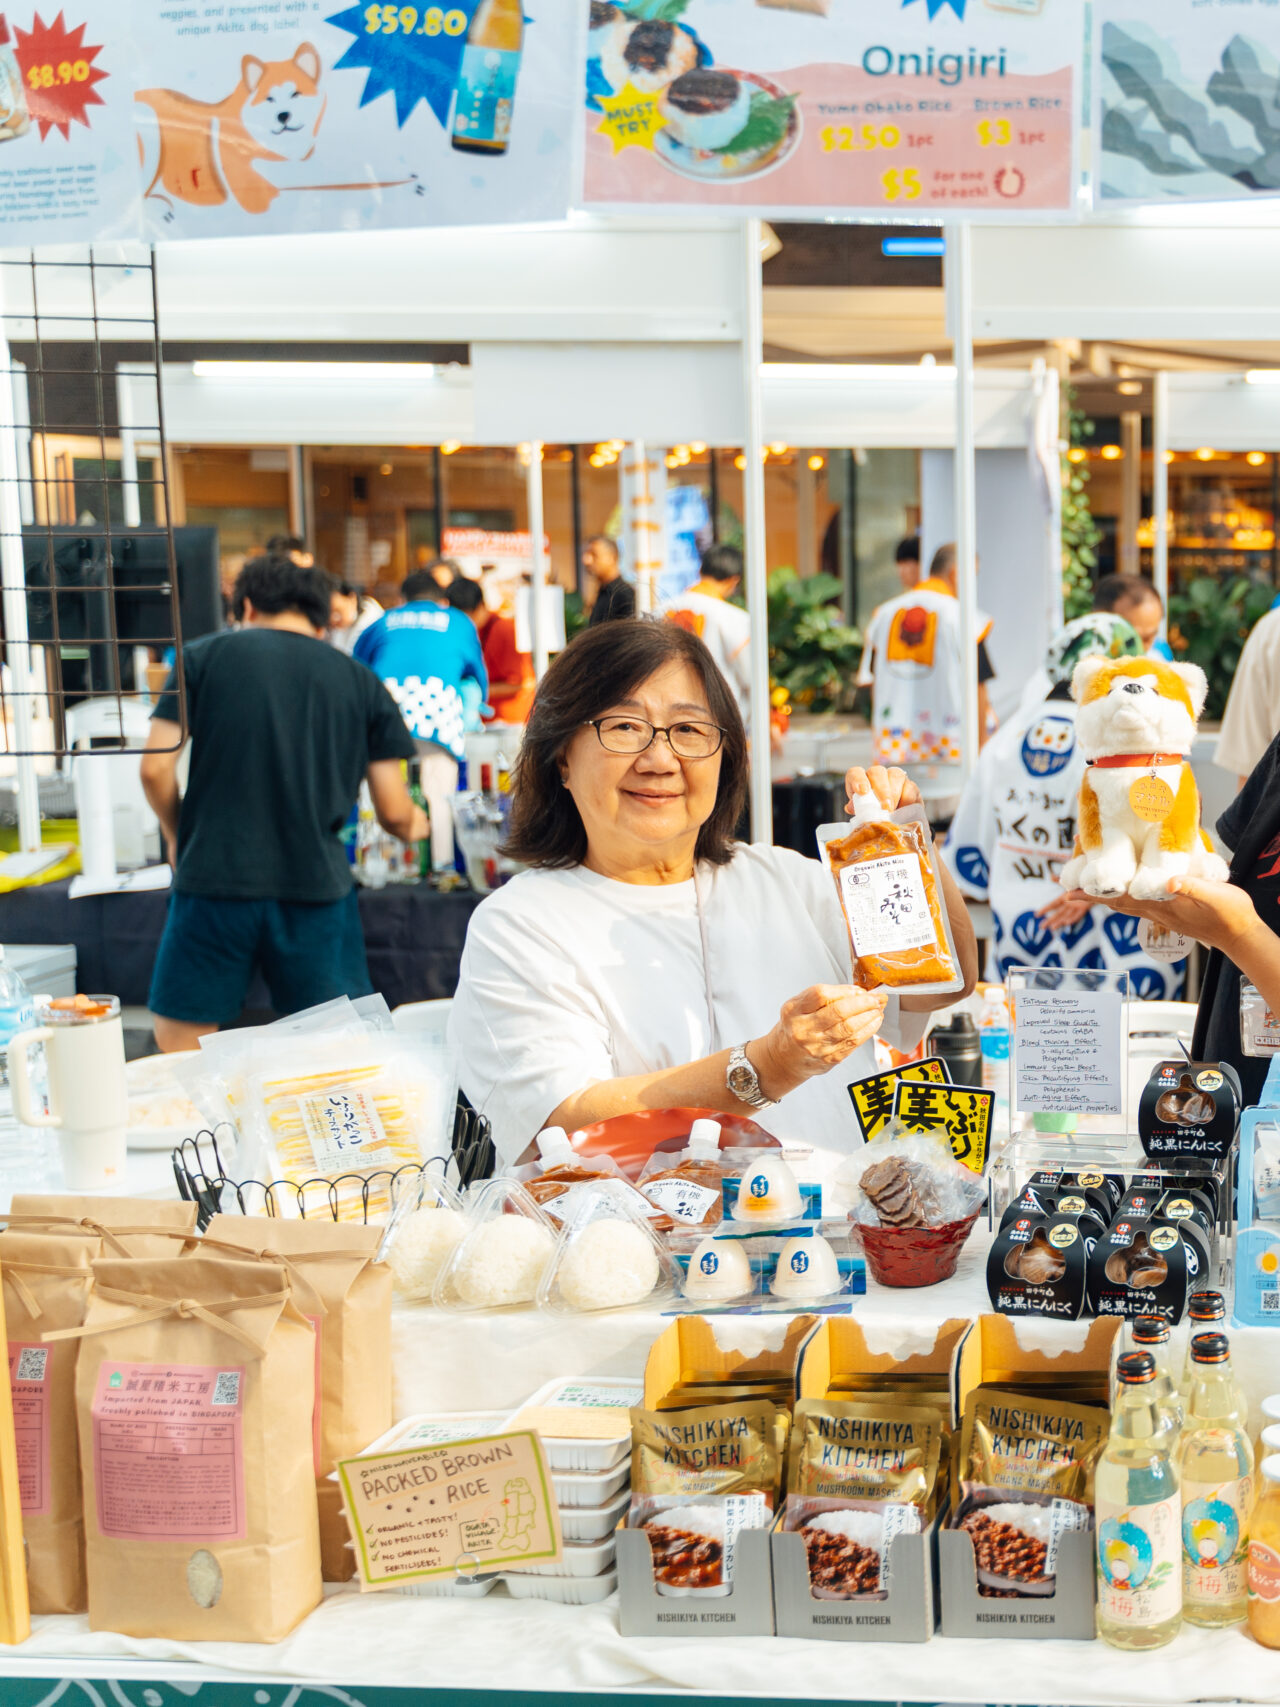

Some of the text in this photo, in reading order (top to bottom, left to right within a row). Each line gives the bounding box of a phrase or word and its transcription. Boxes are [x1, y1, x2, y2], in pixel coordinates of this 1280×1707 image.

[205, 6, 224, 16] and
[229, 4, 282, 17] presented
[364, 3, 468, 37] $59.80
[177, 25, 212, 37] unique
[216, 20, 246, 34] Akita
[250, 20, 269, 34] dog
[26, 58, 91, 91] $8.90
[862, 45, 1007, 87] Onigiri
[607, 101, 656, 124] MUST
[918, 99, 952, 113] Rice
[972, 96, 1063, 113] Brown Rice
[616, 117, 650, 137] TRY
[975, 117, 1046, 148] $3 1pc
[820, 124, 934, 153] $2.50 1pc
[881, 166, 923, 202] $5
[1021, 1074, 1040, 1082] Skin
[1149, 1138, 1223, 1152] 純黒にんにく
[996, 1294, 1073, 1315] 純黒にんにく
[1097, 1299, 1175, 1319] 純黒にんにく
[103, 1395, 145, 1404] Imported
[147, 1396, 168, 1404] from
[134, 1408, 176, 1417] polished
[178, 1409, 188, 1417] in
[191, 1410, 237, 1418] SINGAPORE
[653, 1416, 750, 1444] NISHIKIYA
[818, 1416, 915, 1444] NISHIKIYA
[989, 1406, 1085, 1441] NISHIKIYA
[662, 1443, 742, 1470] KITCHEN
[821, 1443, 906, 1471] KITCHEN
[991, 1434, 1076, 1464] KITCHEN
[360, 1442, 514, 1501] PACKED BROWN
[446, 1477, 491, 1504] RICE
[816, 1483, 865, 1496] MUSHROOM
[993, 1473, 1062, 1491] CHANA MASALA
[376, 1512, 459, 1534] ORGANIC TASTY!
[379, 1528, 450, 1548] NO PESTICIDES!
[466, 1538, 493, 1548] AKITA
[381, 1546, 441, 1561] NO CHEMICAL
[383, 1557, 443, 1574] FERTILISERS!
[1195, 1574, 1222, 1595] 梅
[1110, 1596, 1134, 1617] 梅
[656, 1612, 737, 1623] NISHIKIYA KITCHEN
[812, 1615, 892, 1626] NISHIKIYA KITCHEN
[976, 1613, 1056, 1624] NISHIKIYA KITCHEN
